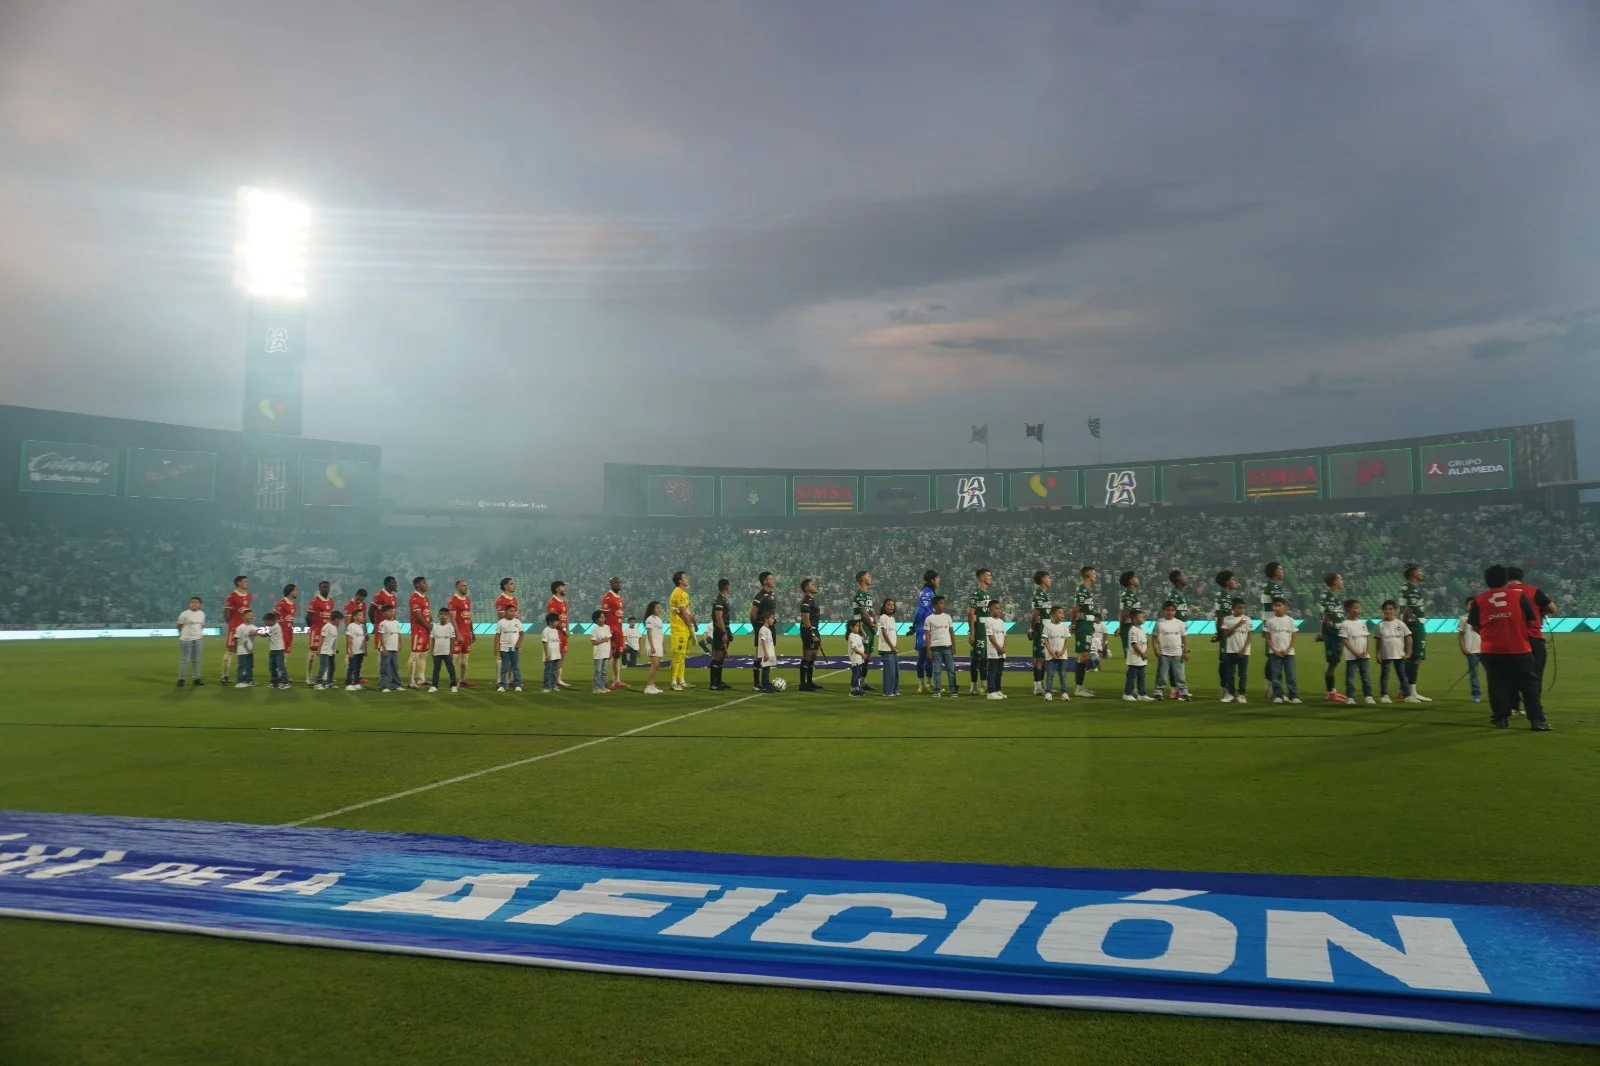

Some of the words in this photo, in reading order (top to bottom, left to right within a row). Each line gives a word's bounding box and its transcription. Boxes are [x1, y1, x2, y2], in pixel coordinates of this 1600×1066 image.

[28, 452, 111, 474] Caliente
[1448, 458, 1482, 468] GRUPO
[1448, 464, 1504, 476] ALAMEDA
[1246, 466, 1317, 485] SIMSA
[795, 484, 853, 500] SIMSA
[1487, 612, 1512, 621] CHARLY
[976, 640, 986, 648] 25
[110, 862, 256, 886] DE
[222, 870, 347, 896] LA
[331, 873, 1492, 995] AFICIÓN
